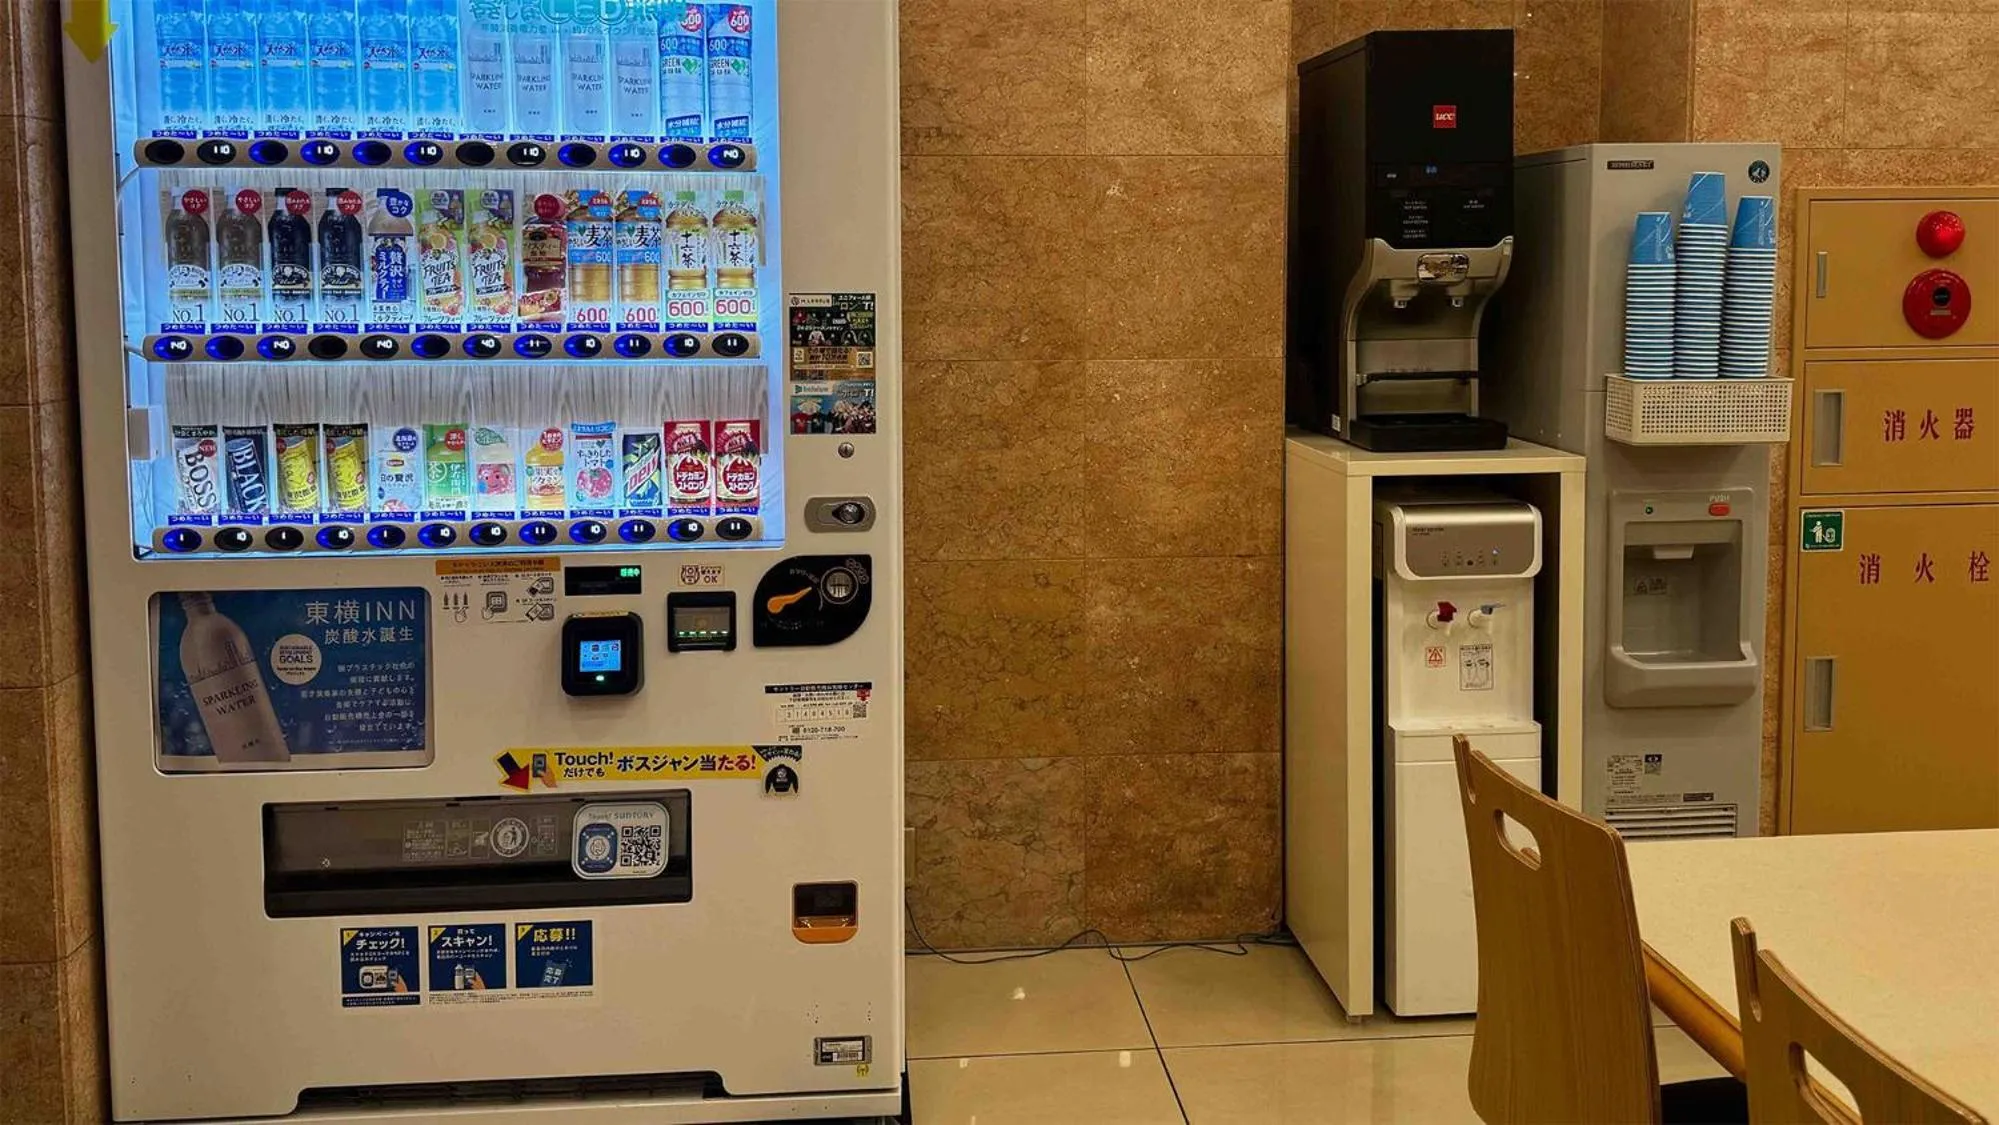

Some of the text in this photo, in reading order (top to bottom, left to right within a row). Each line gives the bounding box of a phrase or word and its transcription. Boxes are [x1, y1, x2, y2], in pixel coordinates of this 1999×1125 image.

[730, 15, 750, 27] 600
[660, 39, 678, 52] 600
[708, 39, 727, 52] 600
[392, 206, 407, 214] コク
[586, 224, 613, 248] 麦茶
[634, 224, 661, 248] 麦茶
[681, 231, 696, 268] 十六茶
[727, 229, 744, 266] 十六茶
[378, 251, 389, 299] ミルクティー
[423, 260, 456, 277] FRUITS
[473, 260, 506, 279] FRUITS
[431, 274, 452, 287] TEA
[481, 272, 501, 287] TEA
[577, 307, 608, 321] 600
[625, 307, 657, 321] 600
[668, 301, 705, 316] 600
[716, 299, 752, 314] 600
[1884, 407, 1975, 442] 消火器
[584, 459, 605, 467] トマト
[184, 450, 217, 508] BOSS
[231, 446, 268, 513] BLACK
[677, 471, 706, 481] ドデカミン
[727, 471, 756, 481] ドデカミン
[678, 481, 705, 491] ストロング
[728, 481, 754, 490] ストロング
[1859, 551, 1991, 585] 消火栓
[704, 575, 718, 584] OK
[305, 600, 416, 626] 東横INN
[324, 626, 414, 646] 炭酸水誕生
[279, 655, 313, 664] GOALS
[202, 679, 258, 707] SPARKLING
[214, 695, 256, 717] WATER
[554, 751, 614, 767] Touch!
[617, 754, 756, 773] ボスジャン当たる!
[563, 768, 605, 778] だけでも
[614, 810, 654, 819] SUNTORY
[359, 930, 401, 938] キャンペーンを
[441, 935, 493, 948] スキャン!
[533, 927, 576, 943] 応募!!
[356, 938, 405, 950] チェック!
